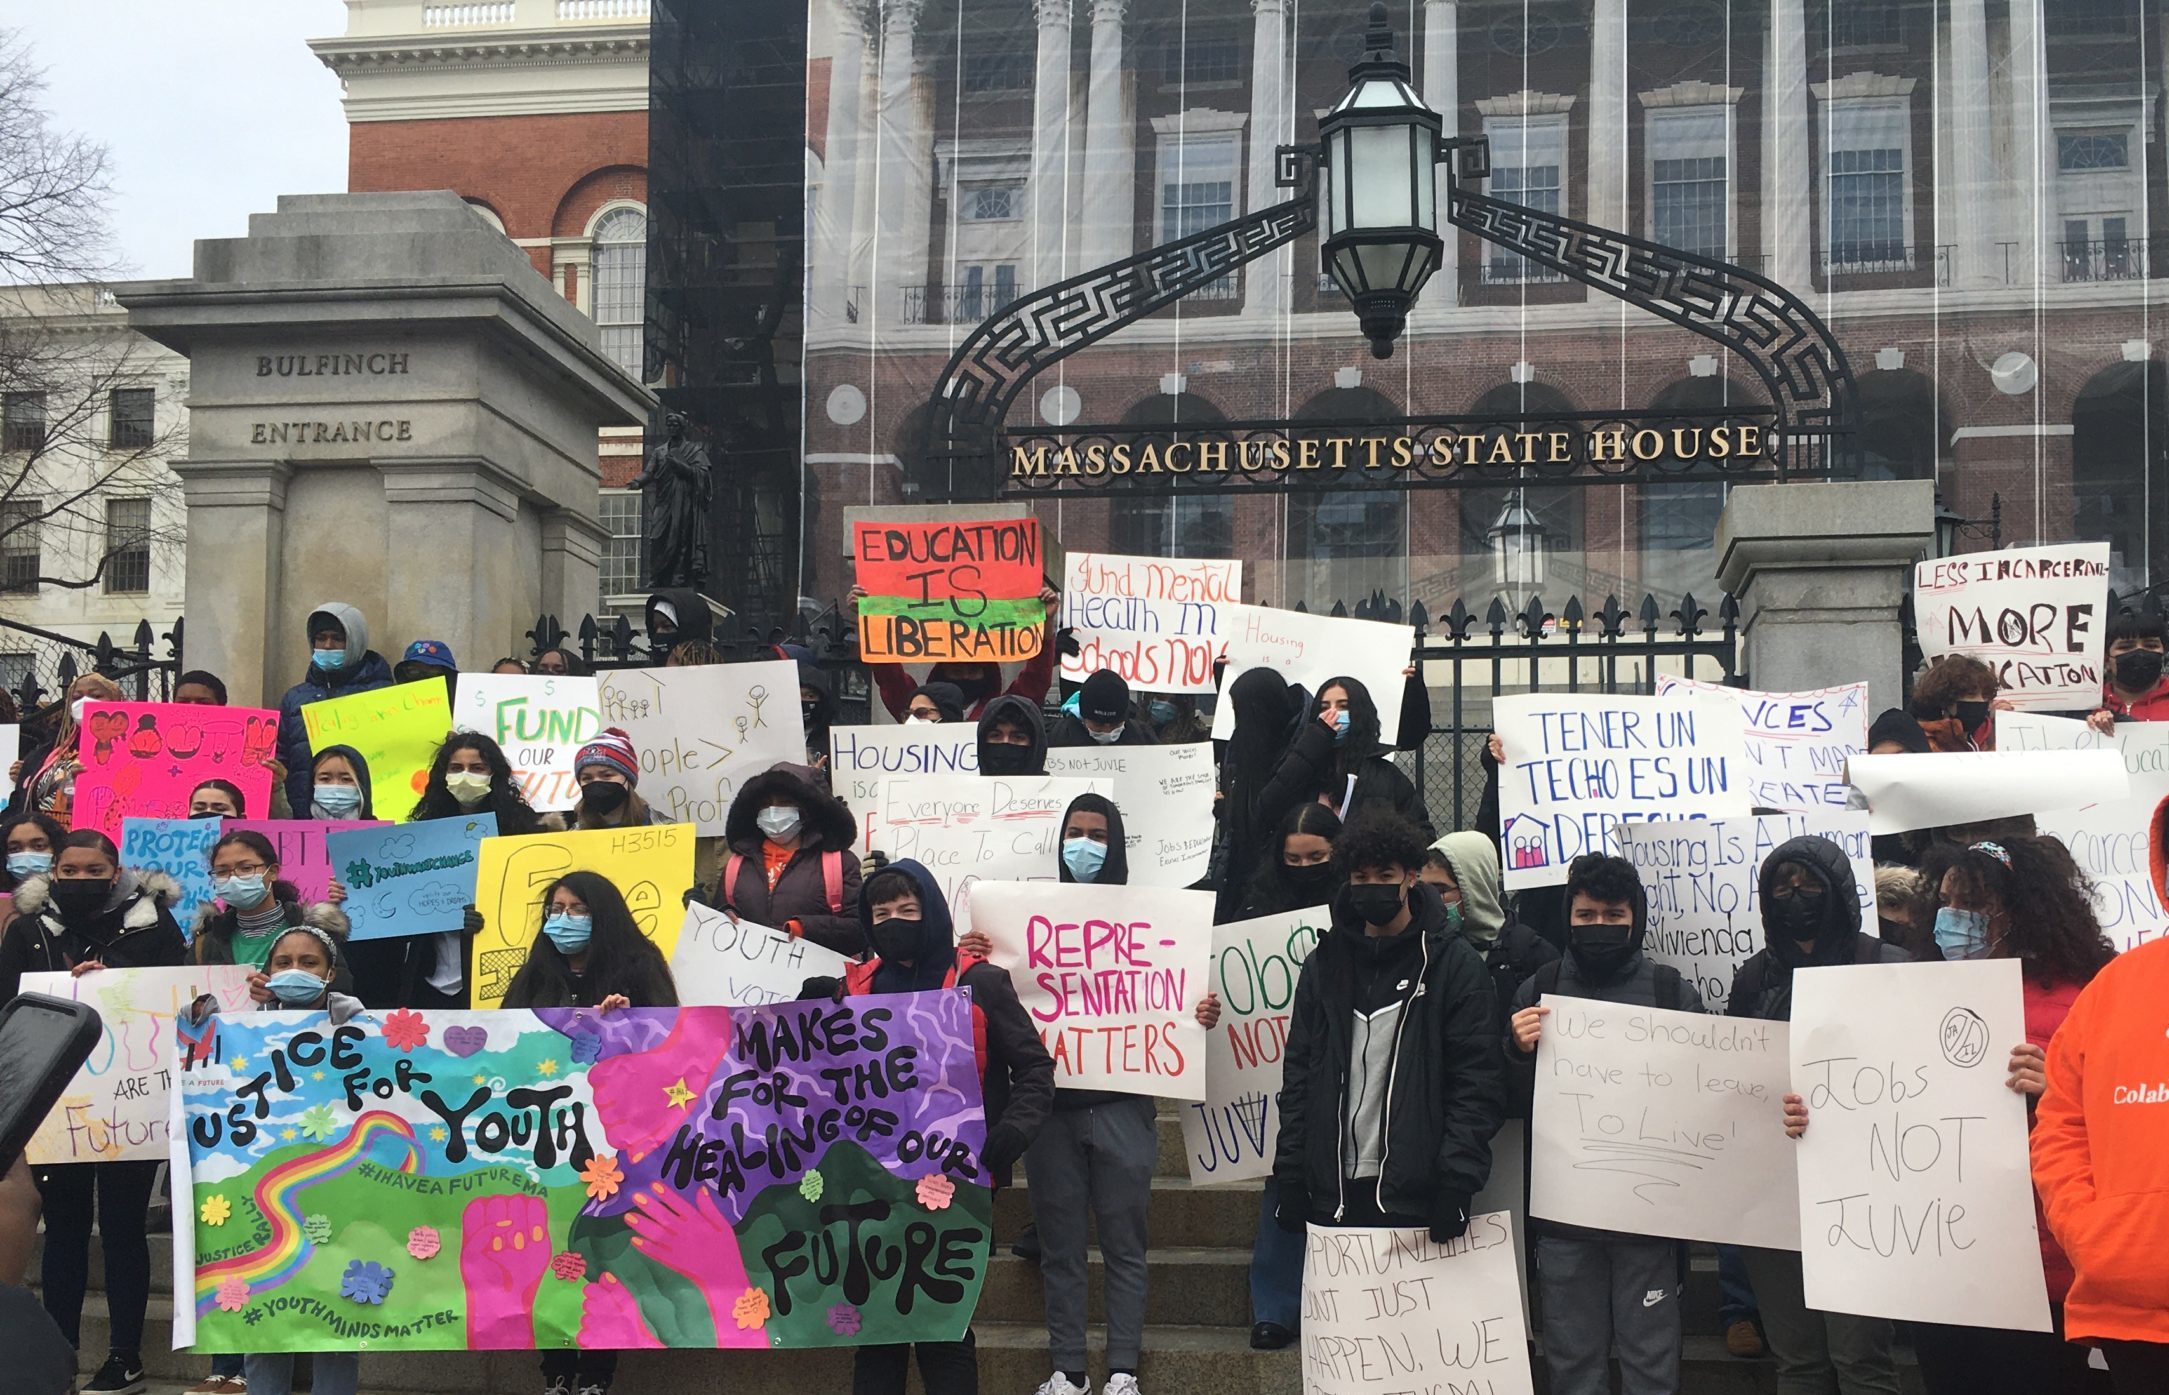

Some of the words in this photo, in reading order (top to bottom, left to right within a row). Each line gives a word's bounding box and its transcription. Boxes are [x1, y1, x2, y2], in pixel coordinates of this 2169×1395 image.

[256, 353, 410, 377] BULFINCH
[251, 419, 413, 444] ENTRANCE
[1011, 437, 1412, 476] MASSACHUSETTS
[1431, 432, 1572, 466] STATE
[1592, 426, 1762, 462] HOUSE
[862, 522, 1036, 567] EDUCATION
[906, 565, 987, 618] IS
[1071, 554, 1135, 597] Fund
[1141, 562, 1241, 604] Mental
[1919, 562, 1969, 589] LESS
[1069, 591, 1159, 634] Health
[1245, 613, 1304, 658] Housing
[1949, 604, 2093, 653] MORE
[864, 614, 1045, 658] LIBERATION
[496, 696, 600, 746] FUND
[1528, 711, 1647, 754] TENER
[1656, 711, 1696, 748] UN
[519, 748, 554, 767] OUR
[641, 737, 699, 777] ople
[834, 732, 980, 773] HOUSING
[1093, 757, 1127, 773] JUVIE
[667, 777, 733, 823] Prof
[1516, 757, 1619, 805] TECHO
[1630, 757, 1678, 800] ES
[1688, 757, 1728, 794] UN
[886, 780, 980, 829] Everyone
[992, 781, 1062, 816] Deserves
[612, 828, 677, 854] H3515
[891, 826, 960, 867] Place
[973, 831, 994, 863] To
[1012, 827, 1056, 856] Call
[1618, 826, 1707, 877] Housing
[1710, 822, 1744, 866] Is
[1755, 818, 1774, 862] A
[1688, 872, 1739, 914] No
[691, 907, 806, 969] YOUTH
[1027, 915, 1176, 970] REPRE-
[1031, 968, 1186, 1023] SENTATION
[737, 1006, 893, 1073] MAKES
[1227, 1015, 1290, 1070] NOT
[1556, 1008, 1606, 1040] We
[114, 1076, 149, 1100] ARE
[198, 1079, 224, 1087] FUTURE
[712, 1068, 809, 1121] FOR
[819, 1045, 919, 1106] THE
[1554, 1045, 1624, 1085] have
[1639, 1062, 1673, 1087] to
[1802, 1057, 1928, 1111] Jobs
[192, 1025, 367, 1150] USTICE
[421, 1084, 597, 1173] YOUTH
[660, 1108, 841, 1199] HEALING
[844, 1105, 899, 1142] OF
[896, 1129, 979, 1179] OUR
[1191, 1091, 1281, 1172] JUV
[1870, 1111, 1987, 1183] NOT
[762, 1199, 984, 1316] FUTURE
[243, 1296, 459, 1338] #YOUTHMINDSMATTER
[1362, 1276, 1434, 1321] JUST
[1436, 1316, 1508, 1370] WE
